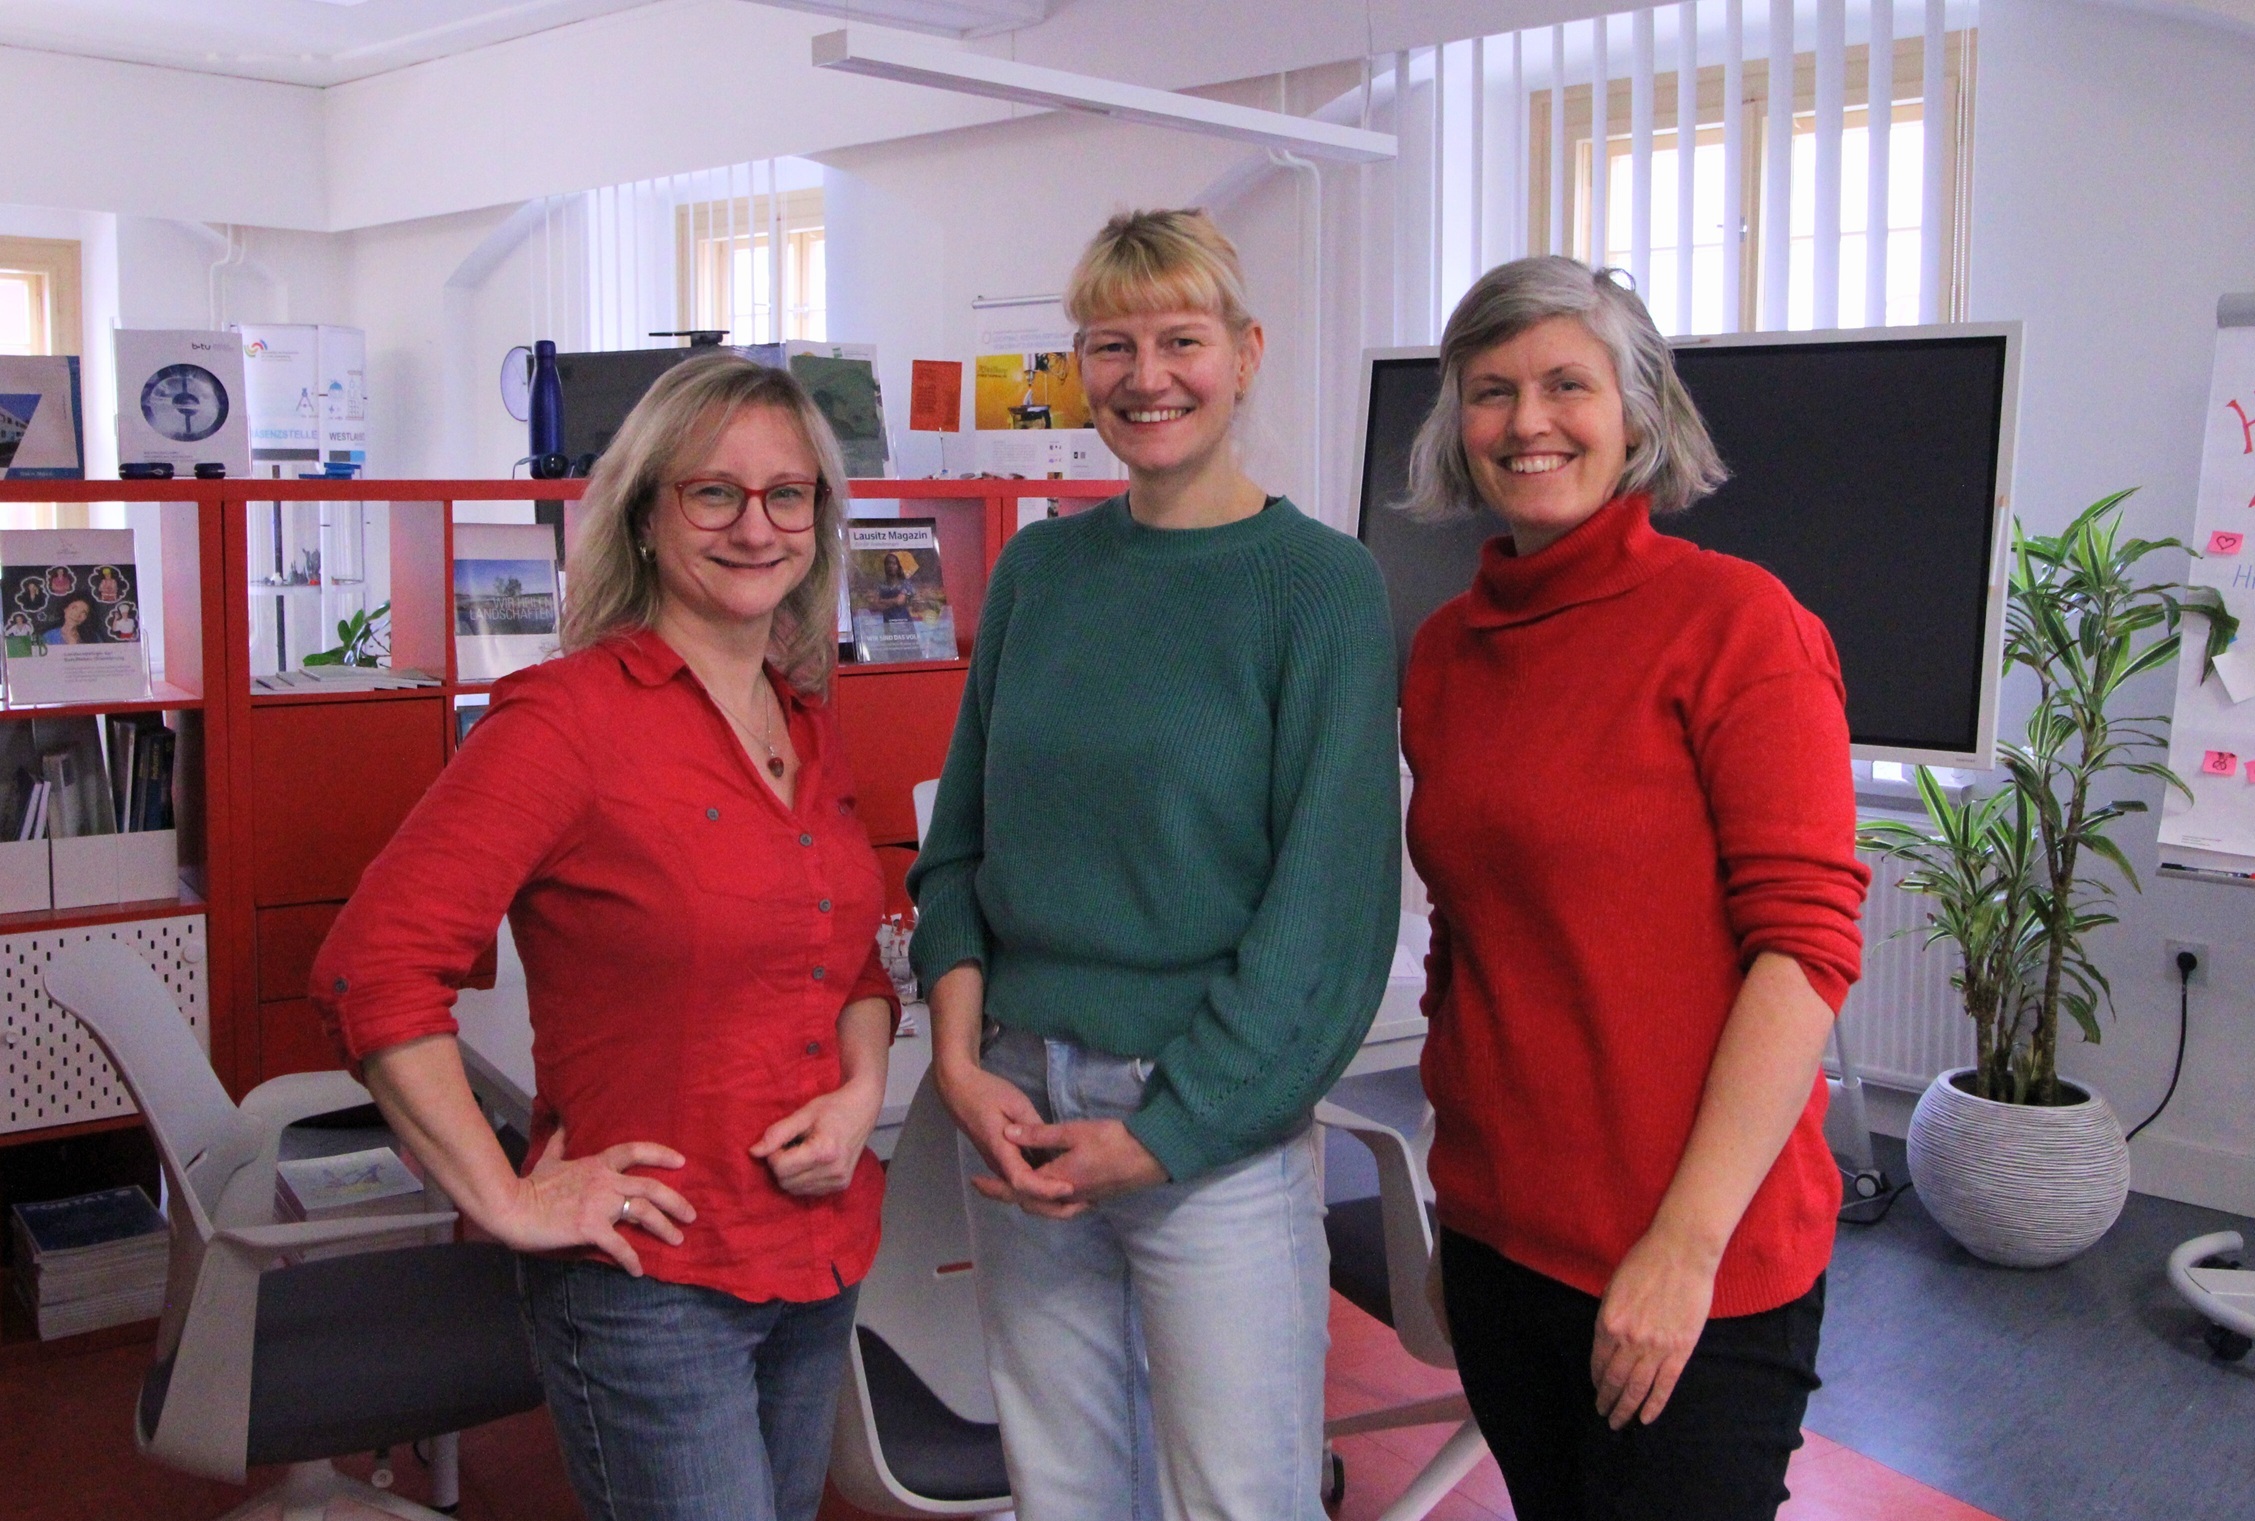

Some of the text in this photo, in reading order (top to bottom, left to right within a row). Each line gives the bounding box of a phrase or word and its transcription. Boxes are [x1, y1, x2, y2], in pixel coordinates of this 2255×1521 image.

[853, 531, 928, 541] Lausitz Magazin
[470, 608, 554, 620] LANDSCHAFTEN
